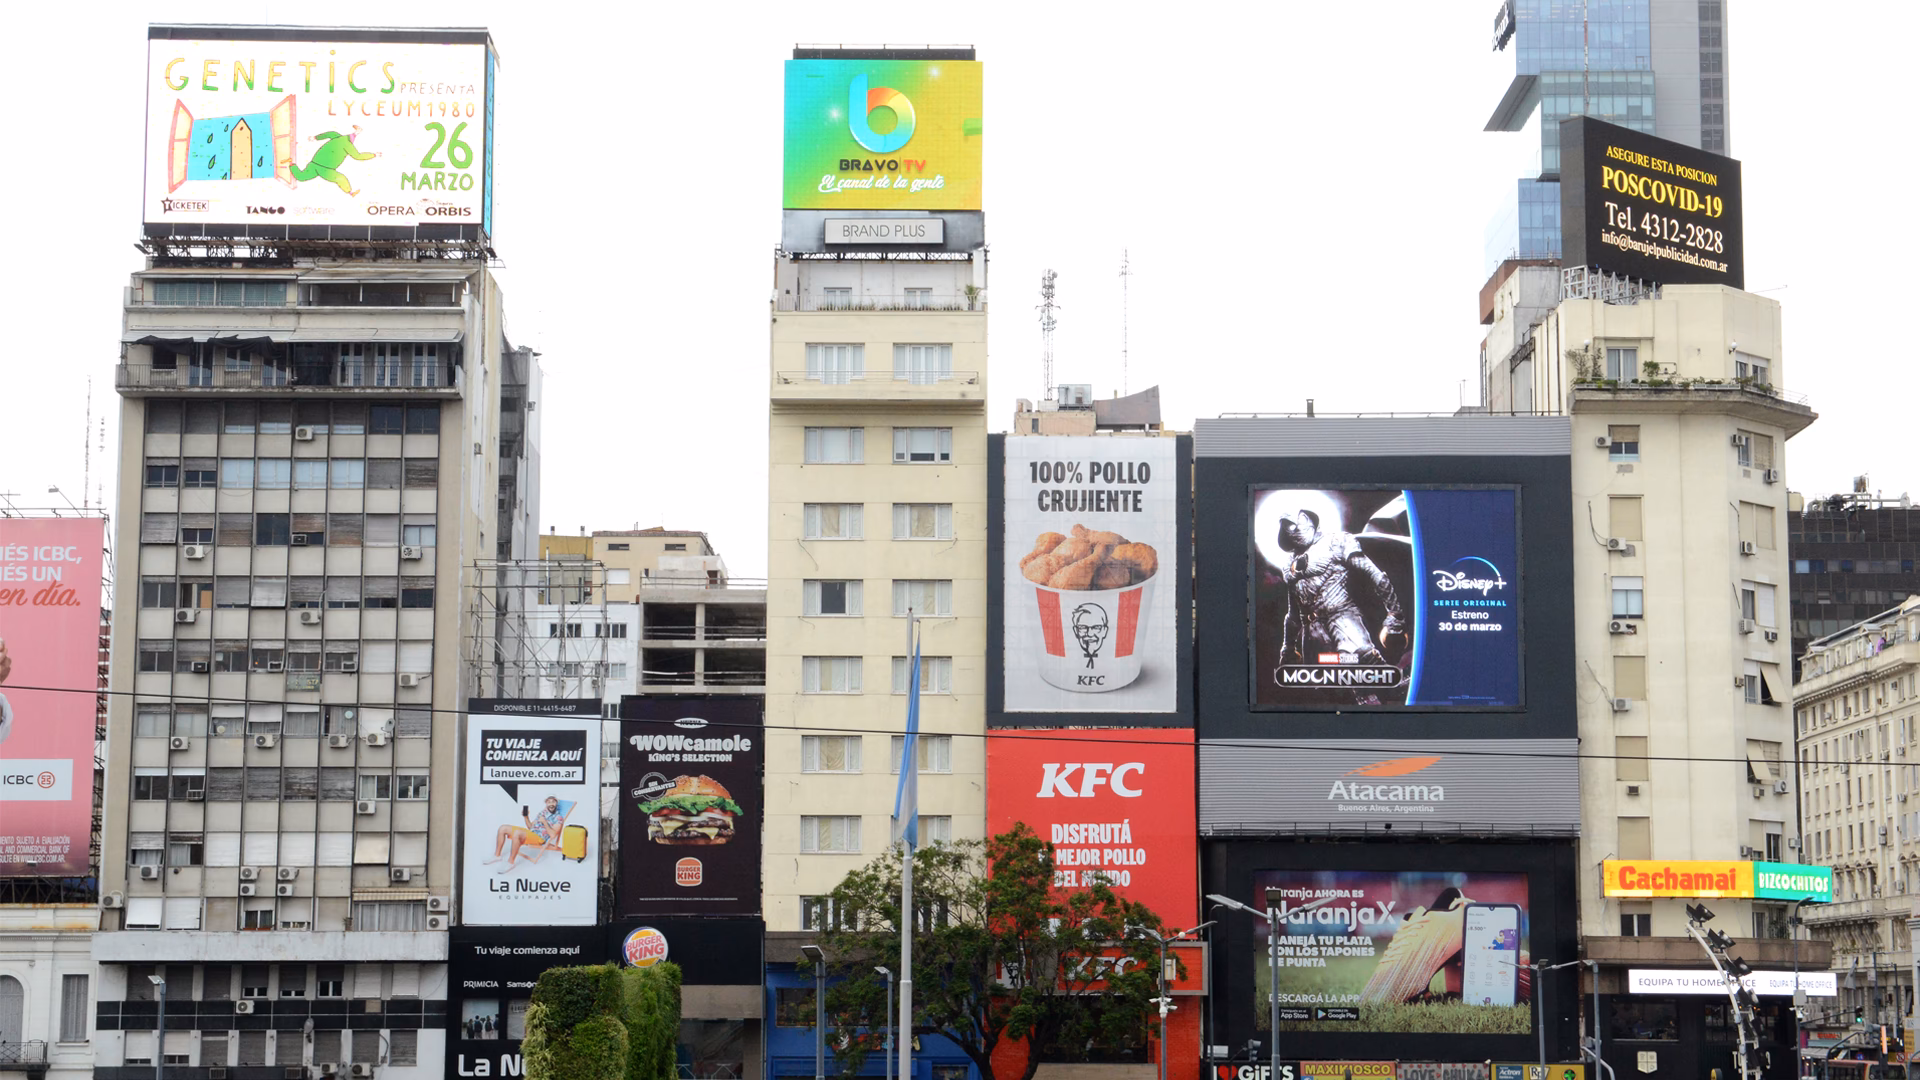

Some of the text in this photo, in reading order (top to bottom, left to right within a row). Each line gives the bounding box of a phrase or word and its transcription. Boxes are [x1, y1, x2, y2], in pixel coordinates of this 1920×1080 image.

[400, 82, 475, 95] PRESENTA
[420, 121, 473, 169] 26
[839, 159, 927, 172] BRAVO TV
[1606, 146, 1717, 186] ASEGURE ESTA POSICION
[400, 171, 474, 191] MARZO
[818, 174, 944, 192] El canal de la gente
[1602, 166, 1723, 218] POSCOVID-19
[163, 200, 207, 211] TICKETEK
[246, 205, 285, 214] TANGO
[367, 206, 415, 215] OPERA
[425, 206, 472, 216] ORBIS
[843, 225, 926, 237] BRAND PLUS
[1605, 202, 1723, 253] Tel. 4312-2828
[1602, 228, 1728, 272] info@barujelpublicidad.com.ar
[1030, 461, 1151, 484] 100% POLLO
[1037, 489, 1143, 512] CRUJIENTE
[33, 545, 82, 564] ICBC,
[32, 566, 62, 581] UN
[1451, 610, 1489, 619] Estreno
[1439, 622, 1502, 631] 30 de marzo
[1077, 675, 1105, 686] KFC
[1338, 669, 1395, 686] KNIGHT
[486, 738, 542, 749] TU VIAJE
[630, 734, 752, 752] WOWcamole
[485, 747, 584, 762] COMIENZA AQUÍ
[682, 753, 732, 762] SELECTION
[490, 768, 577, 778] lanueve.com.ar
[3, 775, 34, 785] ICBC
[1036, 762, 1145, 798] KFC
[1328, 780, 1444, 801] Atacama
[1338, 804, 1435, 814] Buenos Aires, Argentina
[1051, 819, 1132, 844] DISFRUTÁ
[36, 836, 40, 844] A
[1056, 849, 1101, 865] MEJOR
[1103, 849, 1146, 865] POLLO
[677, 872, 700, 880] KING
[1054, 870, 1078, 887] DEL
[1758, 872, 1829, 893] BIZCOCHITOS
[489, 878, 571, 893] La Nueve
[1314, 889, 1350, 898] AHORA
[1352, 889, 1364, 898] ES
[626, 935, 662, 952] BURGER
[1318, 935, 1334, 945] TU
[1335, 935, 1373, 945] PLATA
[474, 945, 580, 956] Tu viaje comienza aquí
[628, 943, 665, 963] KING
[1296, 947, 1319, 956] LOS
[1321, 947, 1375, 956] TAPONES
[1286, 958, 1326, 967] PUNTA
[1638, 978, 1674, 987] EQUIPA
[1677, 978, 1689, 986] TU
[1692, 978, 1721, 987] HOME
[1769, 979, 1789, 988] EQUIPA
[1325, 994, 1339, 1002] LA
[1340, 994, 1360, 1003] APP
[458, 1054, 490, 1077] La
